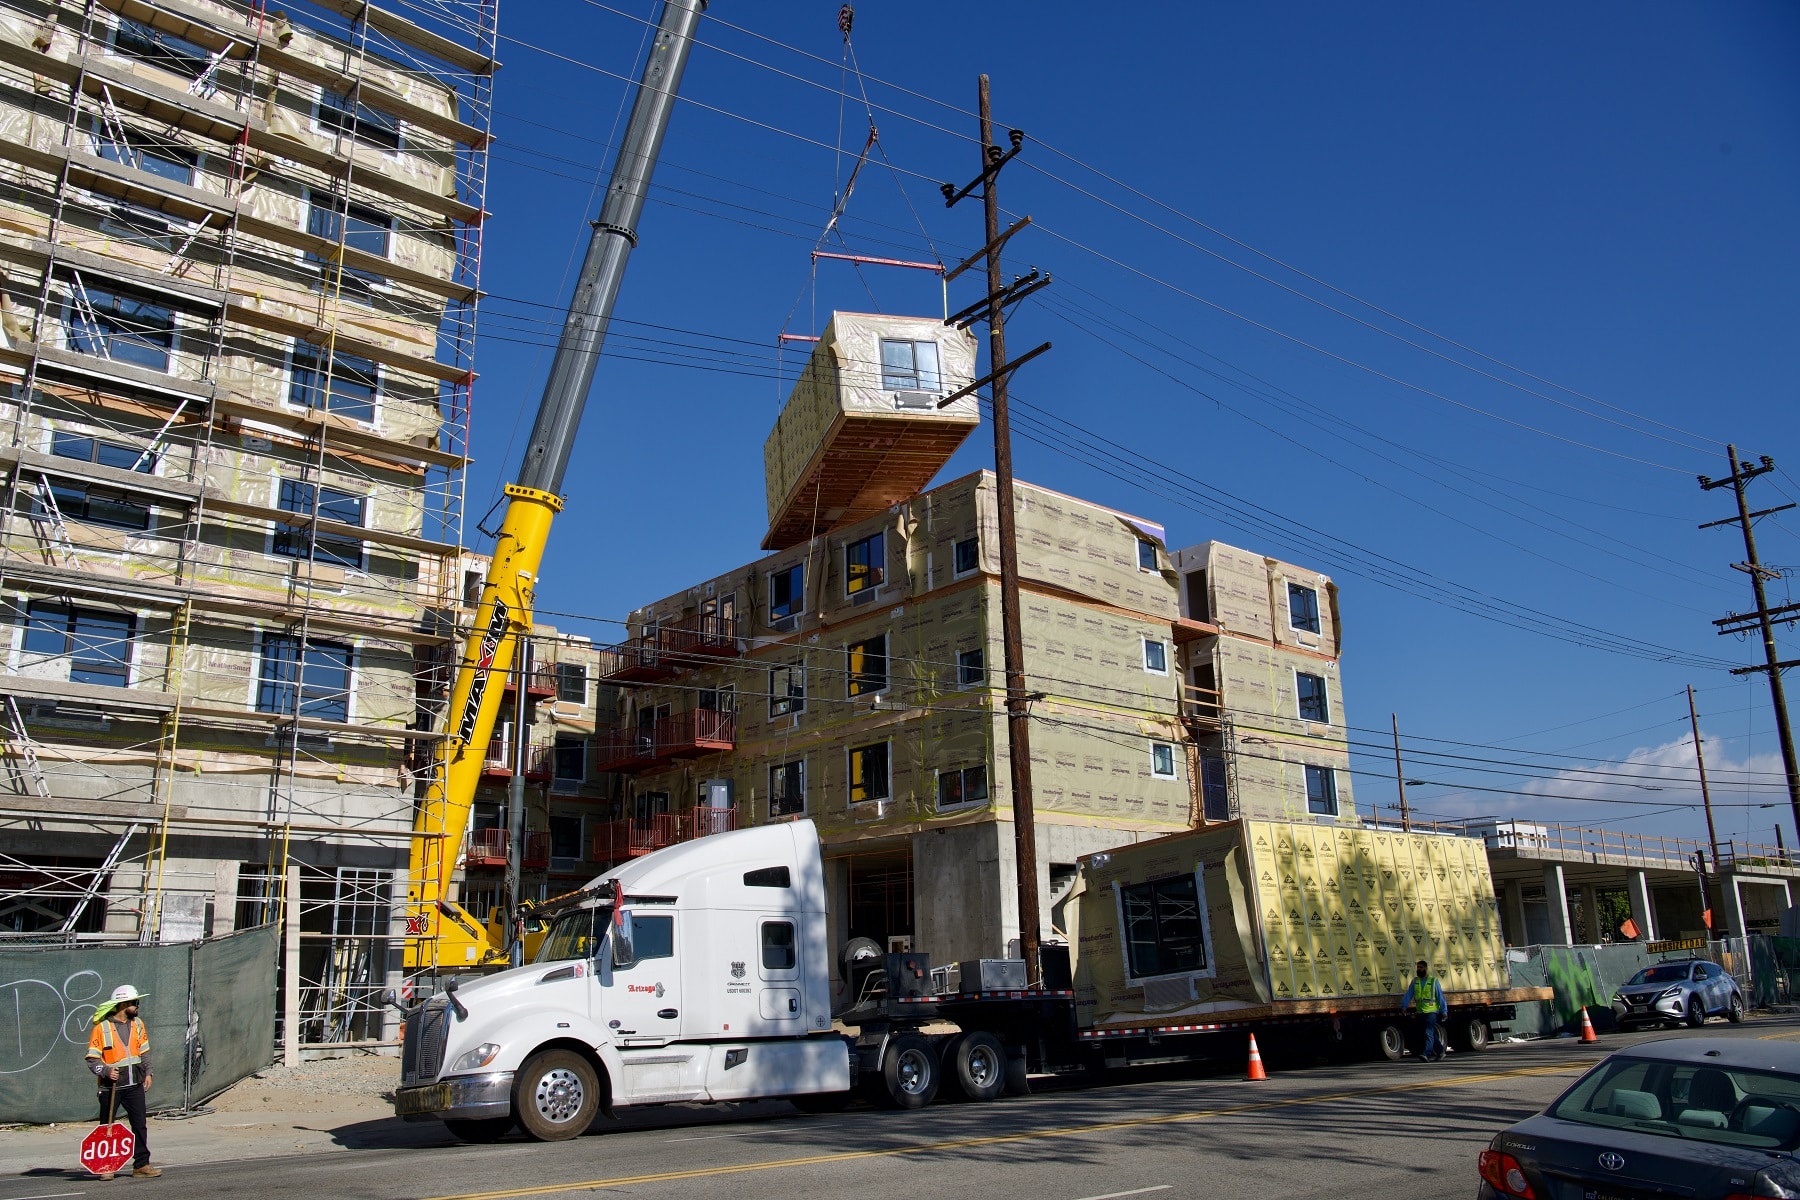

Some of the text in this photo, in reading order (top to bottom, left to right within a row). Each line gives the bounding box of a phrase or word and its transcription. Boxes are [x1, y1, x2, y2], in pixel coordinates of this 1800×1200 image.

[458, 600, 509, 745] MAXIM
[1649, 939, 1705, 952] OVERSIZE LOAD
[83, 1137, 132, 1160] STOP
[1506, 1141, 1536, 1151] COROLLA
